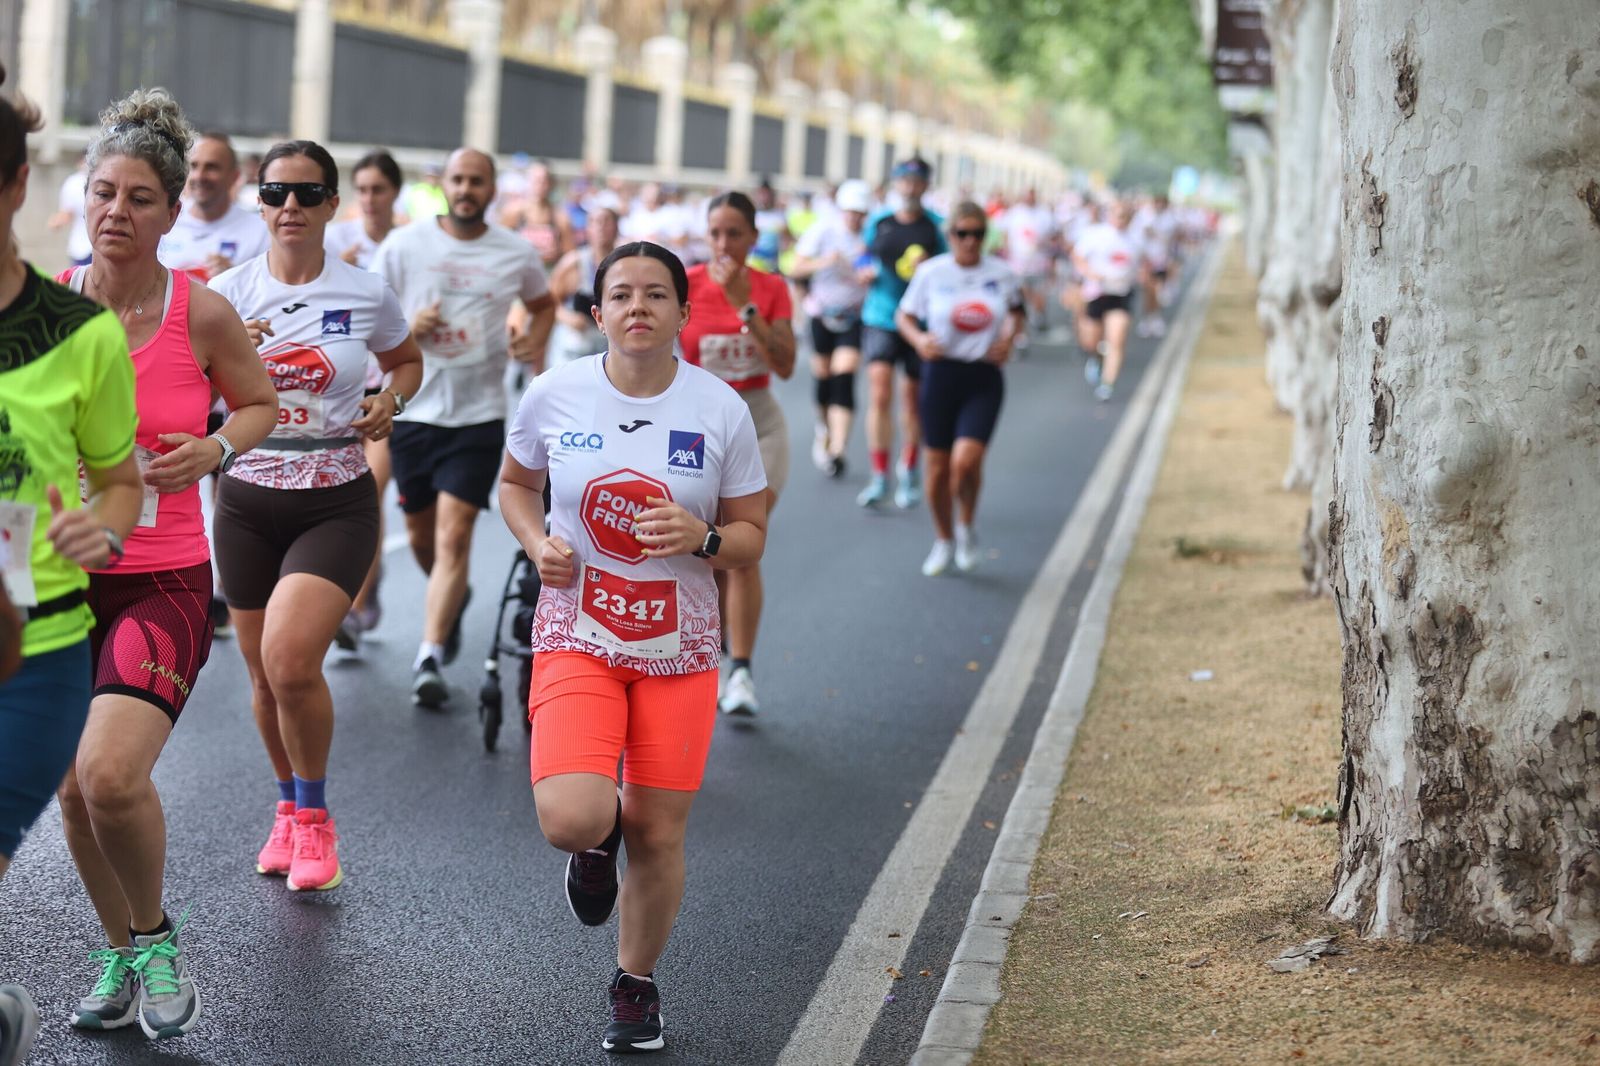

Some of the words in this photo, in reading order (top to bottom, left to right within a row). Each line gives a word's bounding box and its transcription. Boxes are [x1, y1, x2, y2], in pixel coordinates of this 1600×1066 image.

[265, 360, 325, 380] PONLE
[270, 376, 317, 390] RENO
[668, 449, 698, 466] AXA
[667, 468, 704, 479] fundación
[596, 489, 650, 519] PON
[591, 506, 657, 537] FREN
[592, 588, 666, 621] 2347
